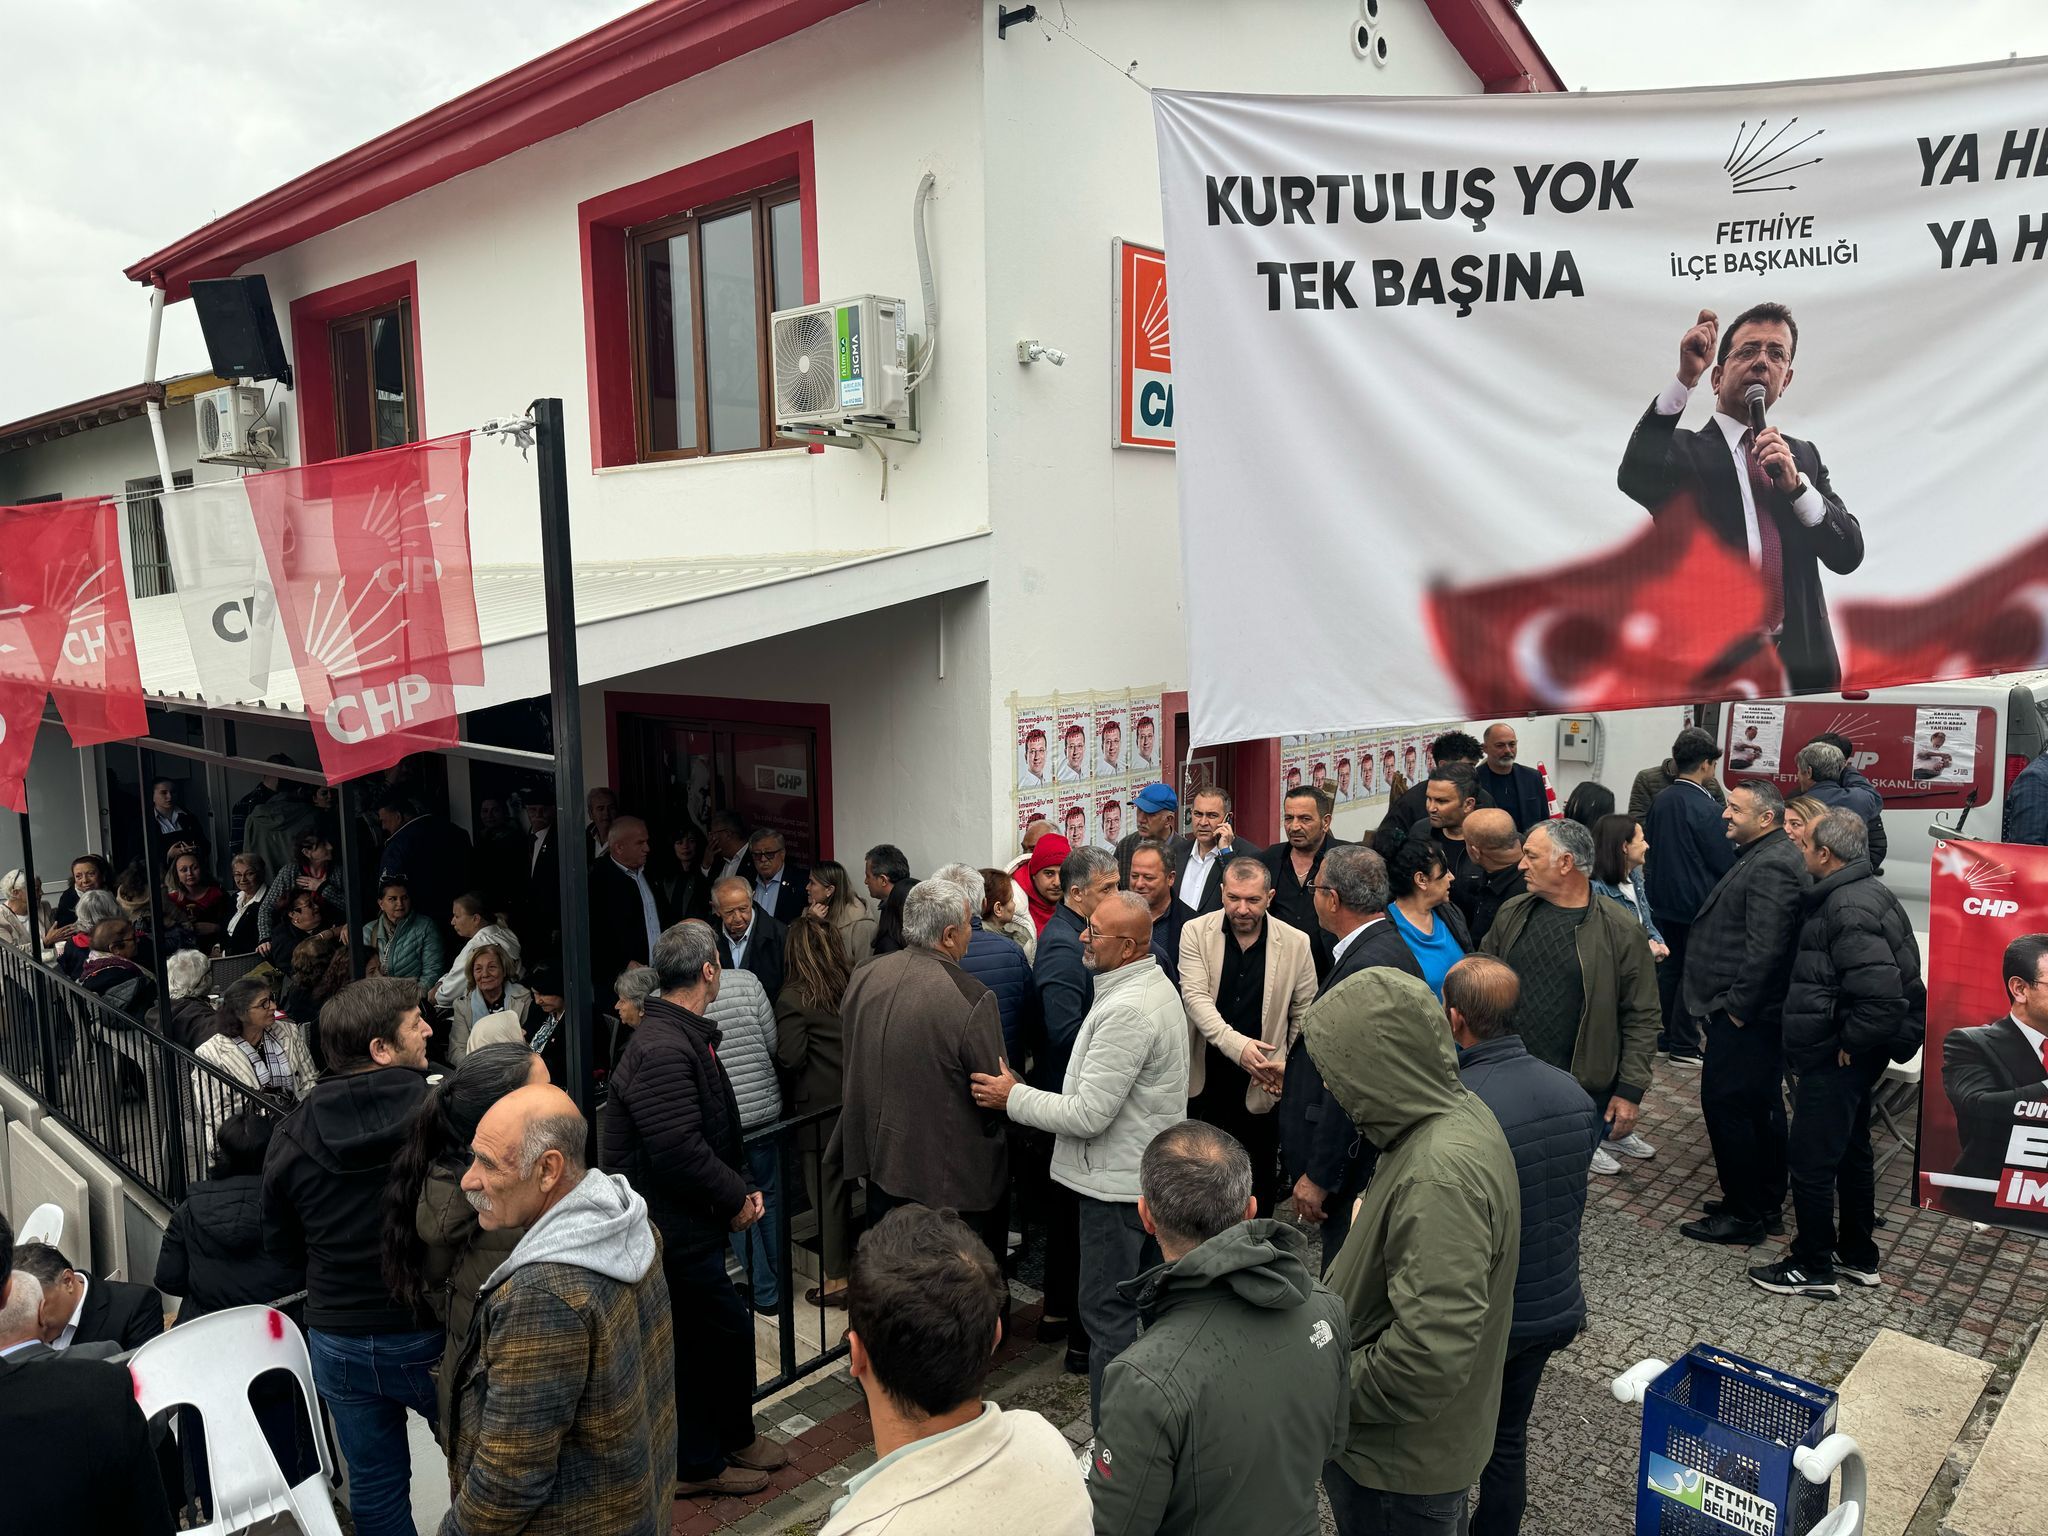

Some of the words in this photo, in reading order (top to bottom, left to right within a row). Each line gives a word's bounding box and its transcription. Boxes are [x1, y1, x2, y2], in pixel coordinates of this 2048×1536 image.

[1916, 133, 1979, 186] YA
[1206, 167, 1496, 232] KURTULUŞ
[1513, 158, 1639, 215] YOK
[1716, 212, 1814, 245] FETHİYE
[1926, 218, 1998, 269] YA
[1670, 252, 1718, 281] İLÇE
[1724, 239, 1858, 276] BAŞKANLIĞI
[1257, 260, 1356, 311] TEK
[1372, 250, 1584, 318] BAŞINA
[62, 620, 134, 666] CHP
[324, 674, 431, 745] CHP
[776, 773, 802, 791] CHP
[1847, 751, 1880, 770] HP
[1962, 897, 2019, 917] CHP
[1703, 1498, 1774, 1536] BELEDİYESİ
[1704, 1480, 1775, 1523] FETHİYE
